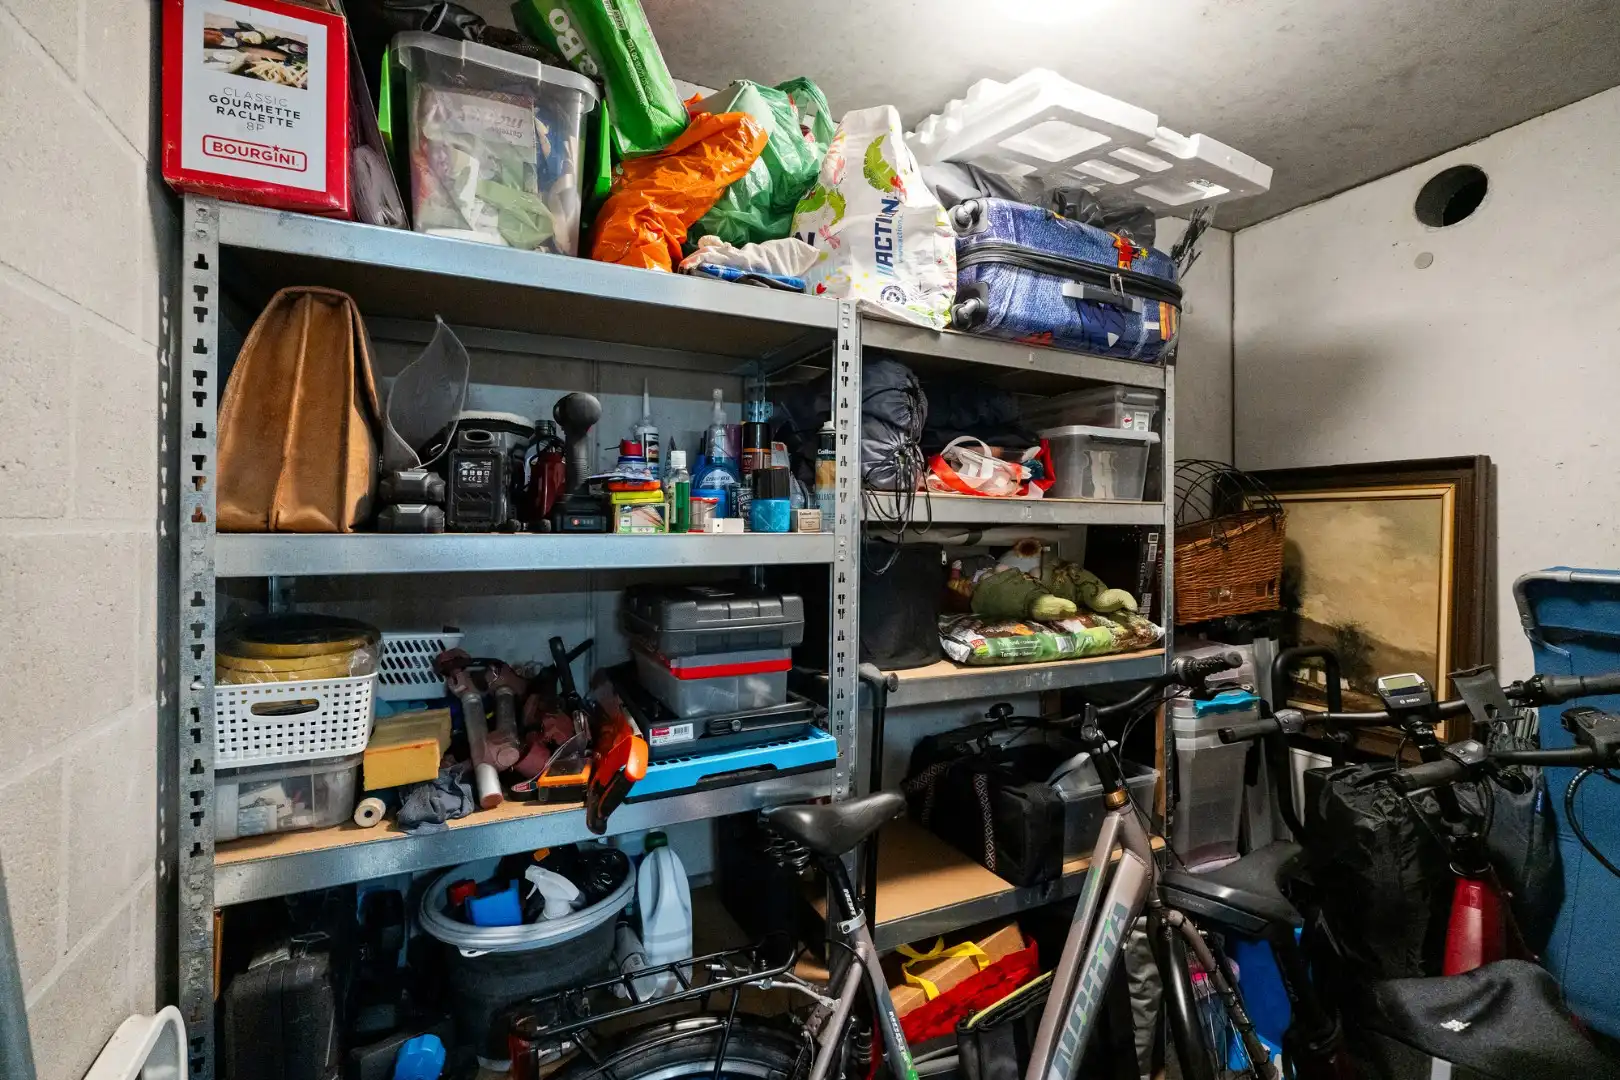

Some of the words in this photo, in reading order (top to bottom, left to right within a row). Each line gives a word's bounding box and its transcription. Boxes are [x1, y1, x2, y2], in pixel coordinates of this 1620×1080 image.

[208, 94, 301, 120] GOURMETTE
[223, 87, 288, 107] CLASSIC
[216, 106, 294, 128] RACLETTE
[246, 121, 265, 131] 8P
[212, 140, 297, 167] BOURGINI
[875, 199, 900, 268] ACTIN
